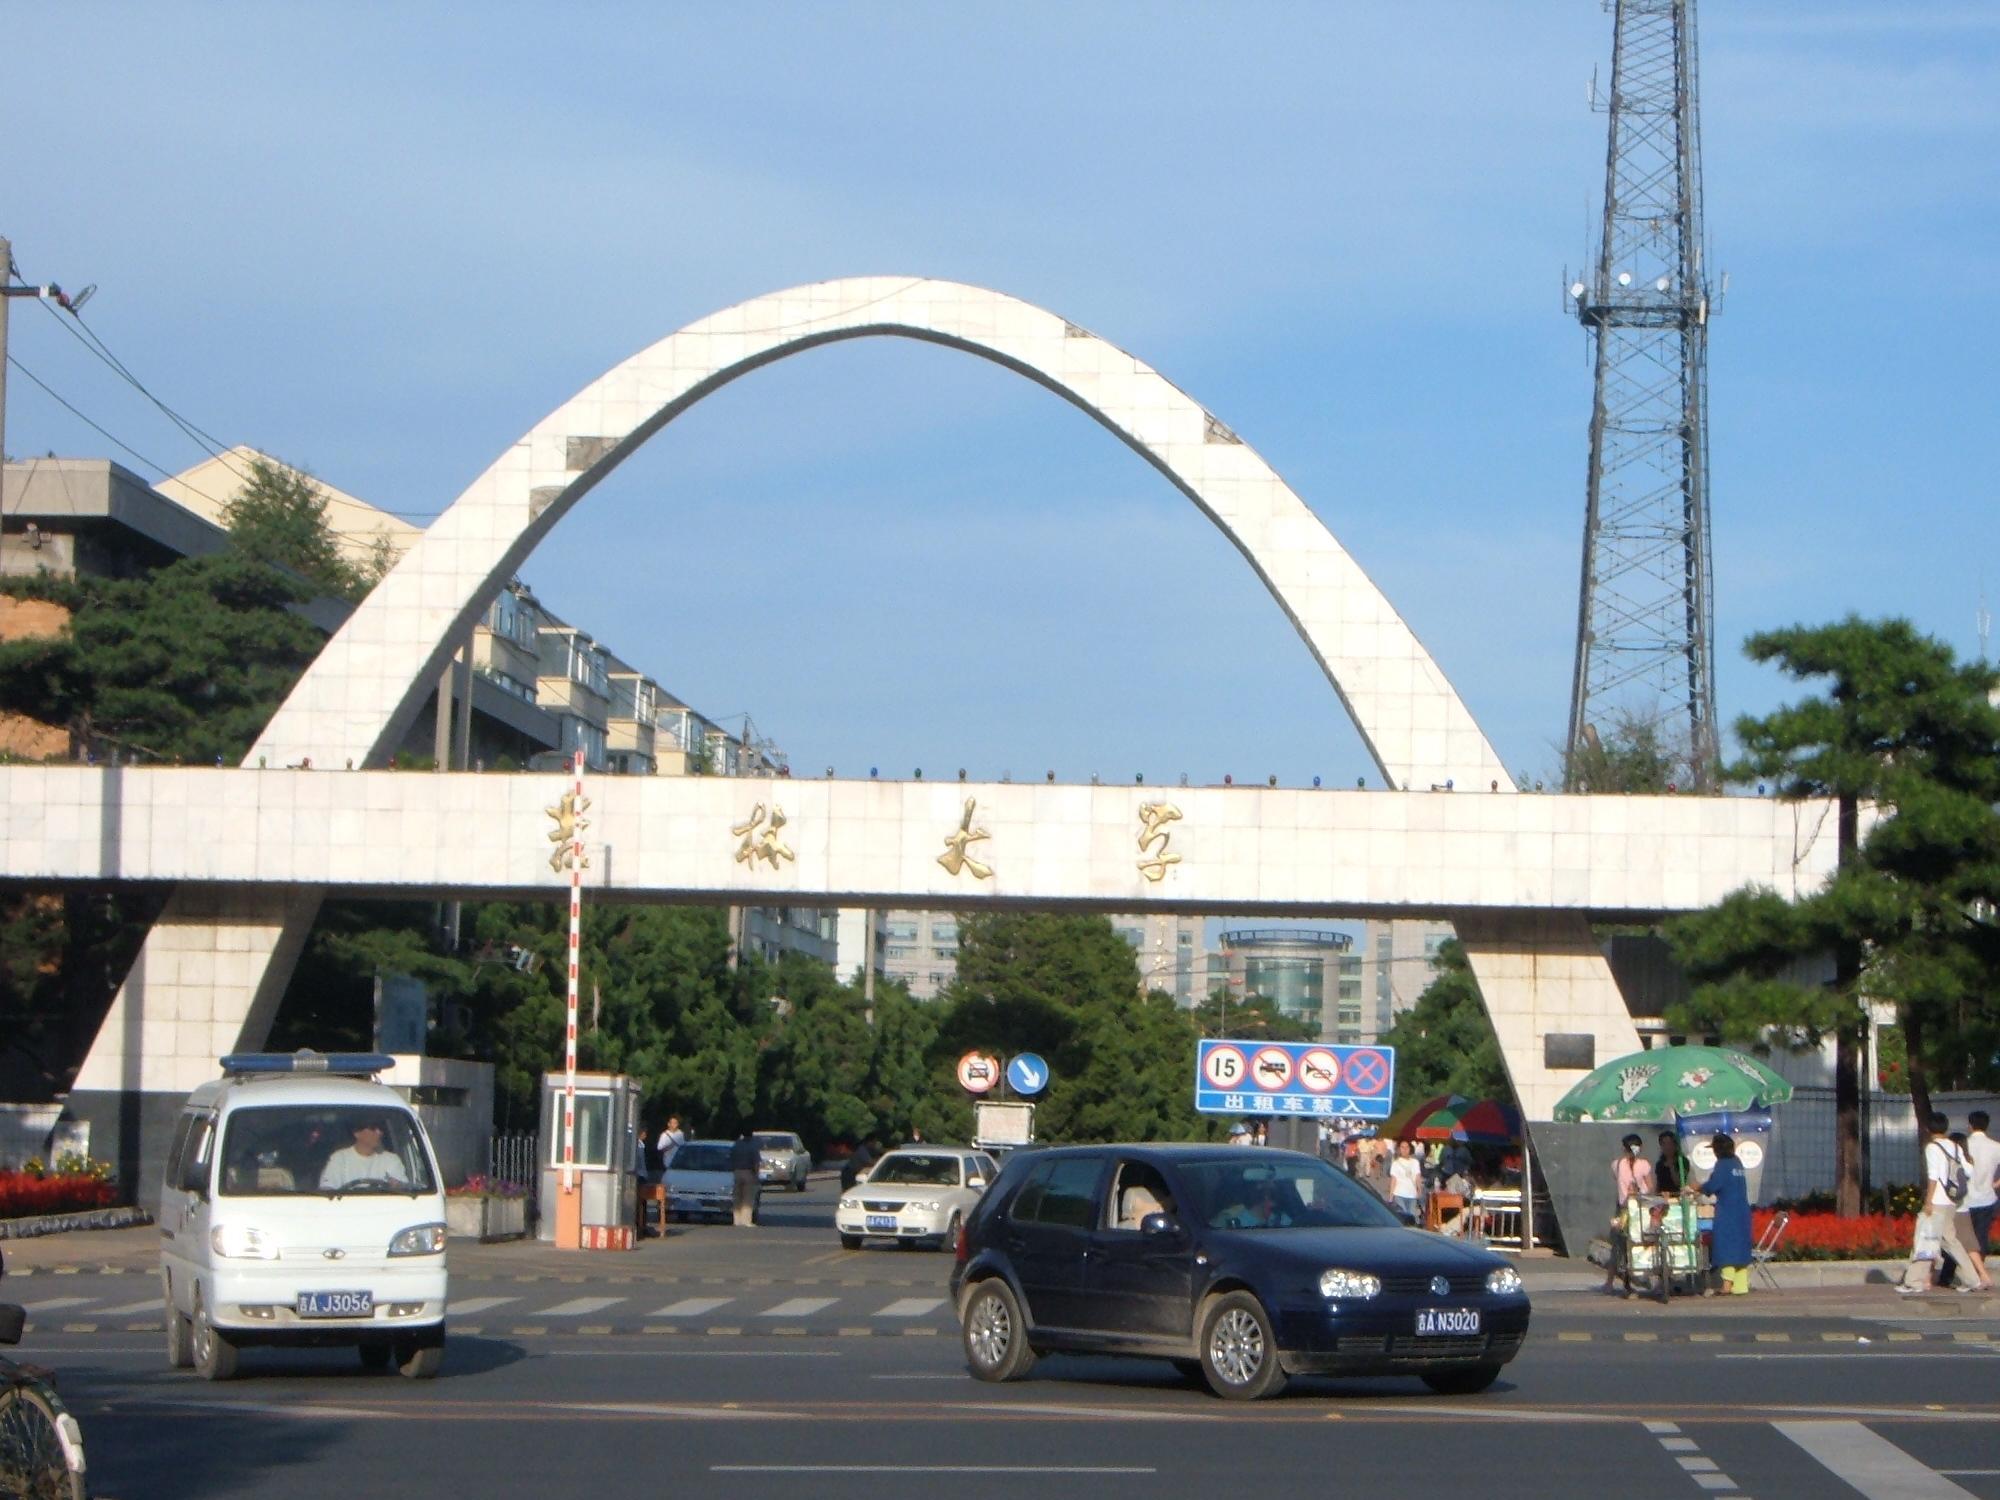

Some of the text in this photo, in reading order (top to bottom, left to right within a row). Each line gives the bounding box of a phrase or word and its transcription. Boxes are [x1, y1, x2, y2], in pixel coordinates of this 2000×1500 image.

[1215, 1057, 1236, 1078] 15
[1224, 1095, 1363, 1113] 出租车禁入
